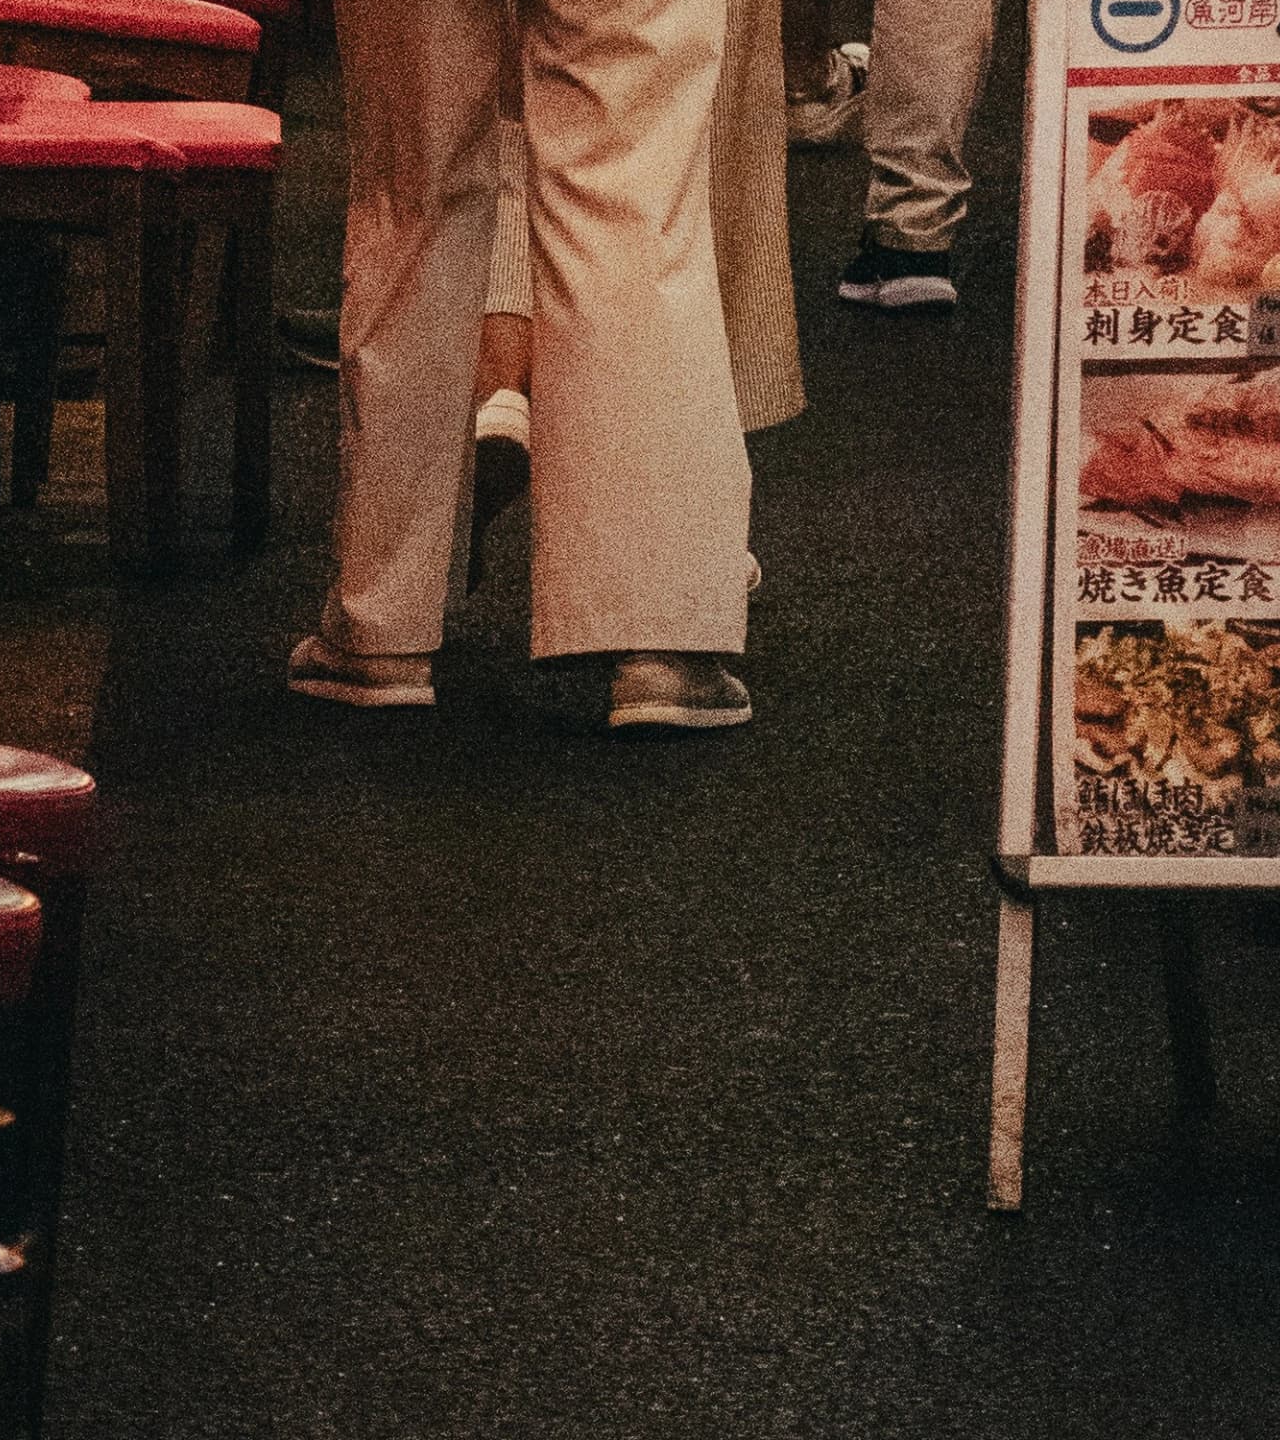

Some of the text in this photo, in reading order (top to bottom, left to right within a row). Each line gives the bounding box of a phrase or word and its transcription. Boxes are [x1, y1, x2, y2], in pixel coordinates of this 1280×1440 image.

[1083, 305, 1248, 346] 刺身定食
[1076, 565, 1275, 604] 焼き魚定食
